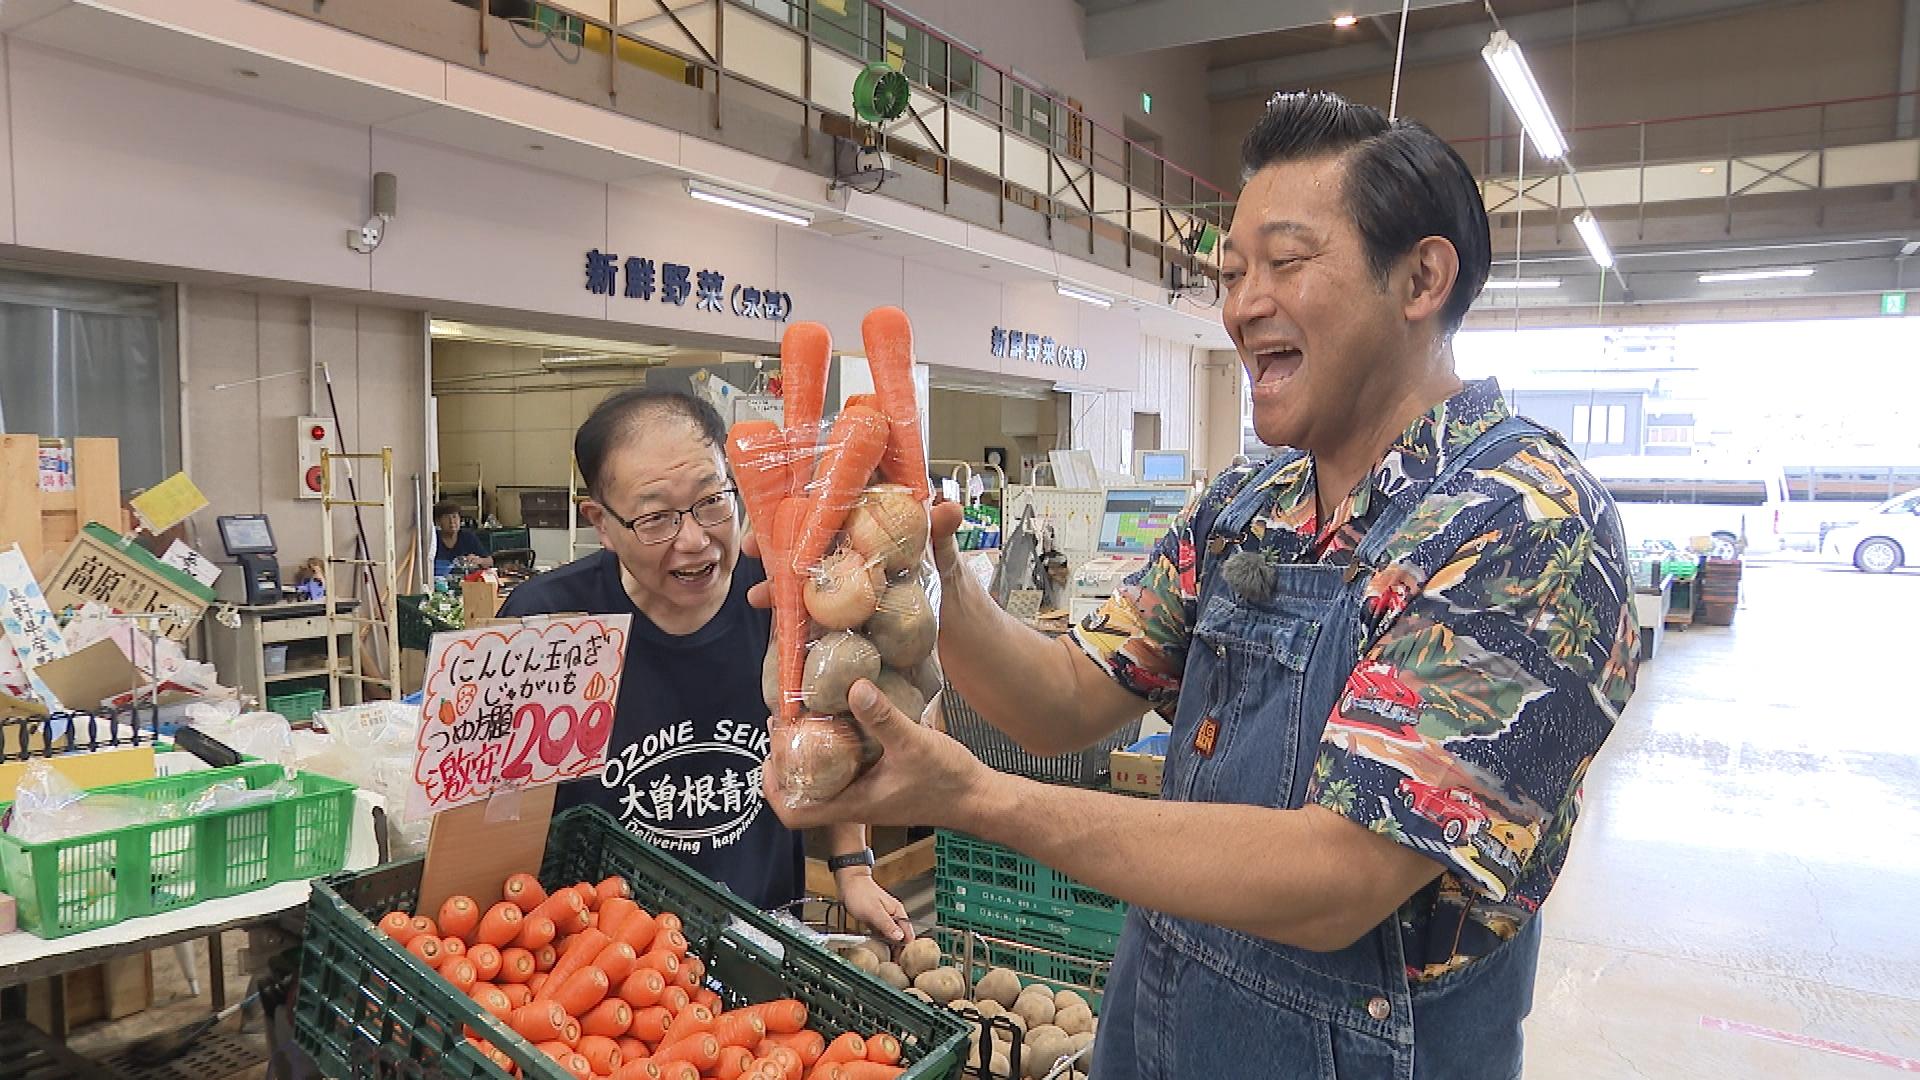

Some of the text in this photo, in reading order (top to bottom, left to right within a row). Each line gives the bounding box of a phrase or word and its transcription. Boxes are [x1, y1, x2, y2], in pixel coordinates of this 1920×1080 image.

[484, 671, 577, 707] じゃがいも
[500, 700, 615, 780] 200
[600, 719, 771, 788] OZONE SEIK
[624, 800, 764, 855] Delivering happiness
